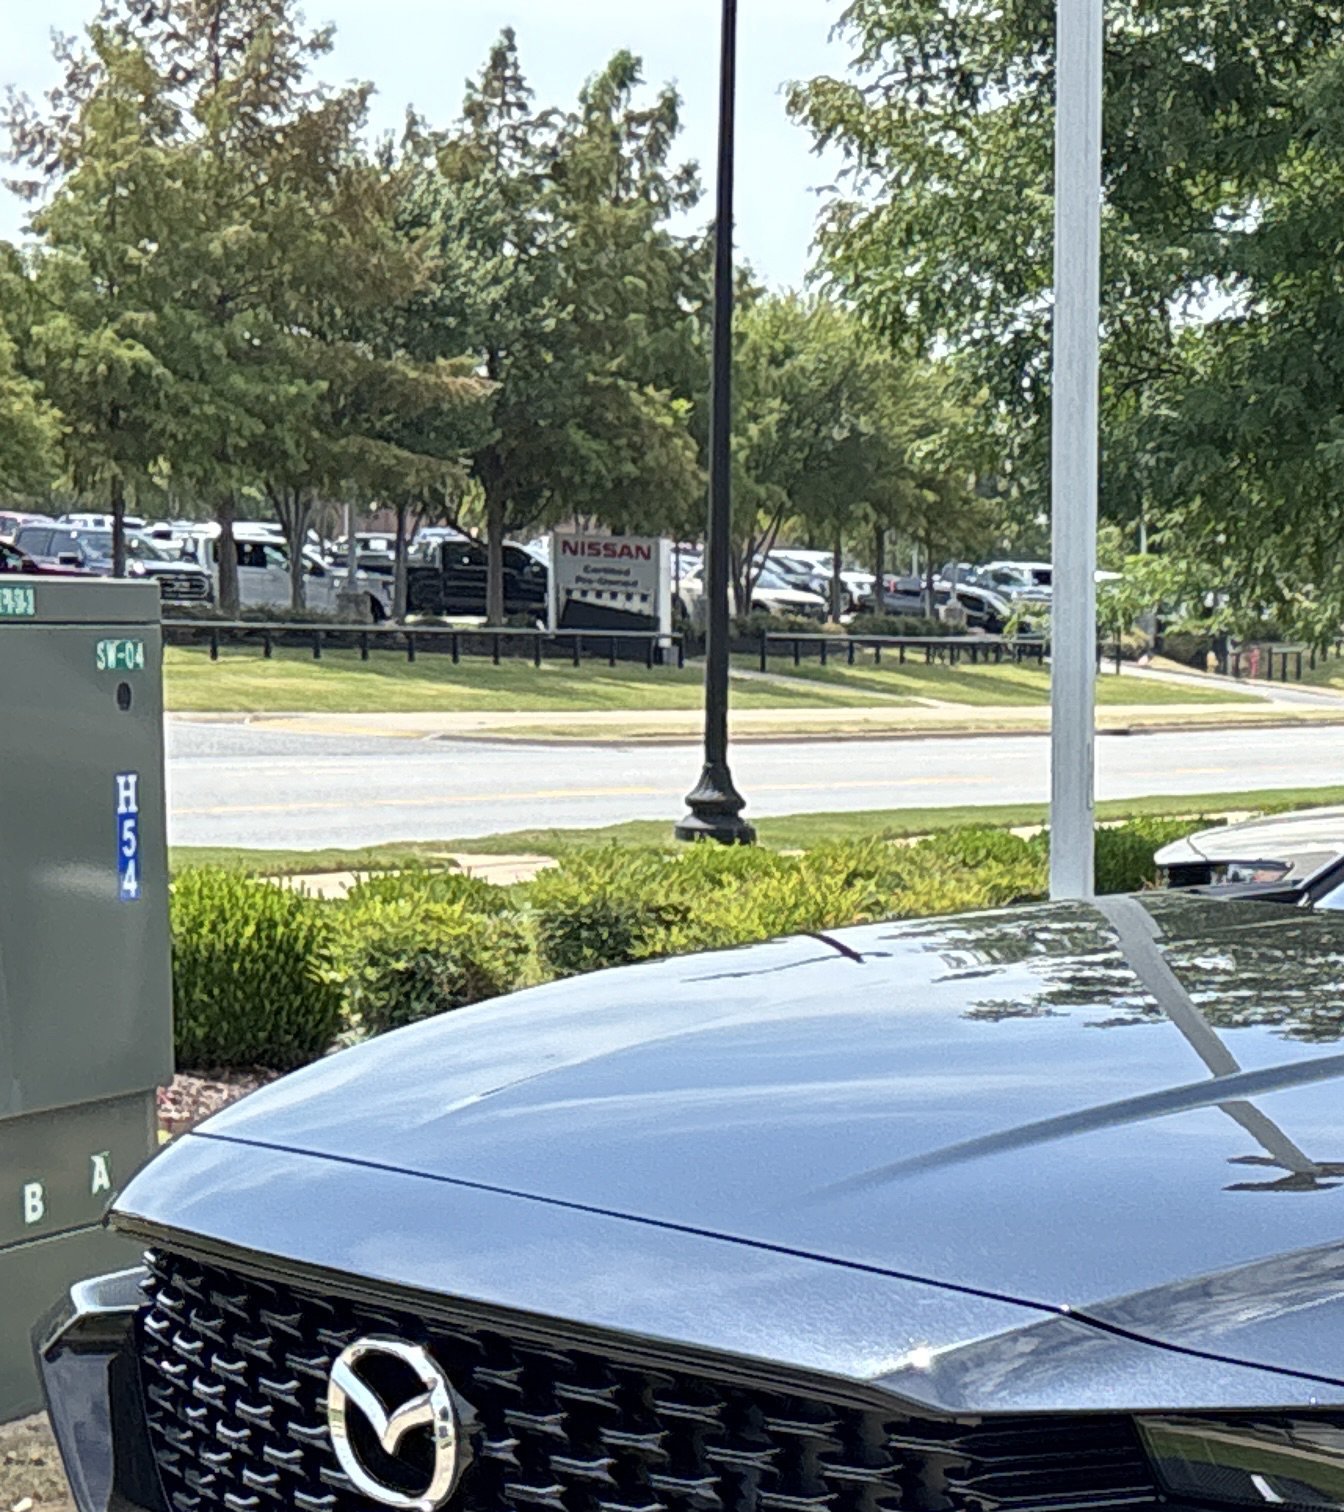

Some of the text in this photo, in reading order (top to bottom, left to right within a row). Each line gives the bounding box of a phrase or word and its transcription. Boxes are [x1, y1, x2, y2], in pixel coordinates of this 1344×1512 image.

[562, 540, 652, 560] NISSAN
[96, 640, 144, 670] SW-04
[24, 1151, 111, 1225] B A
